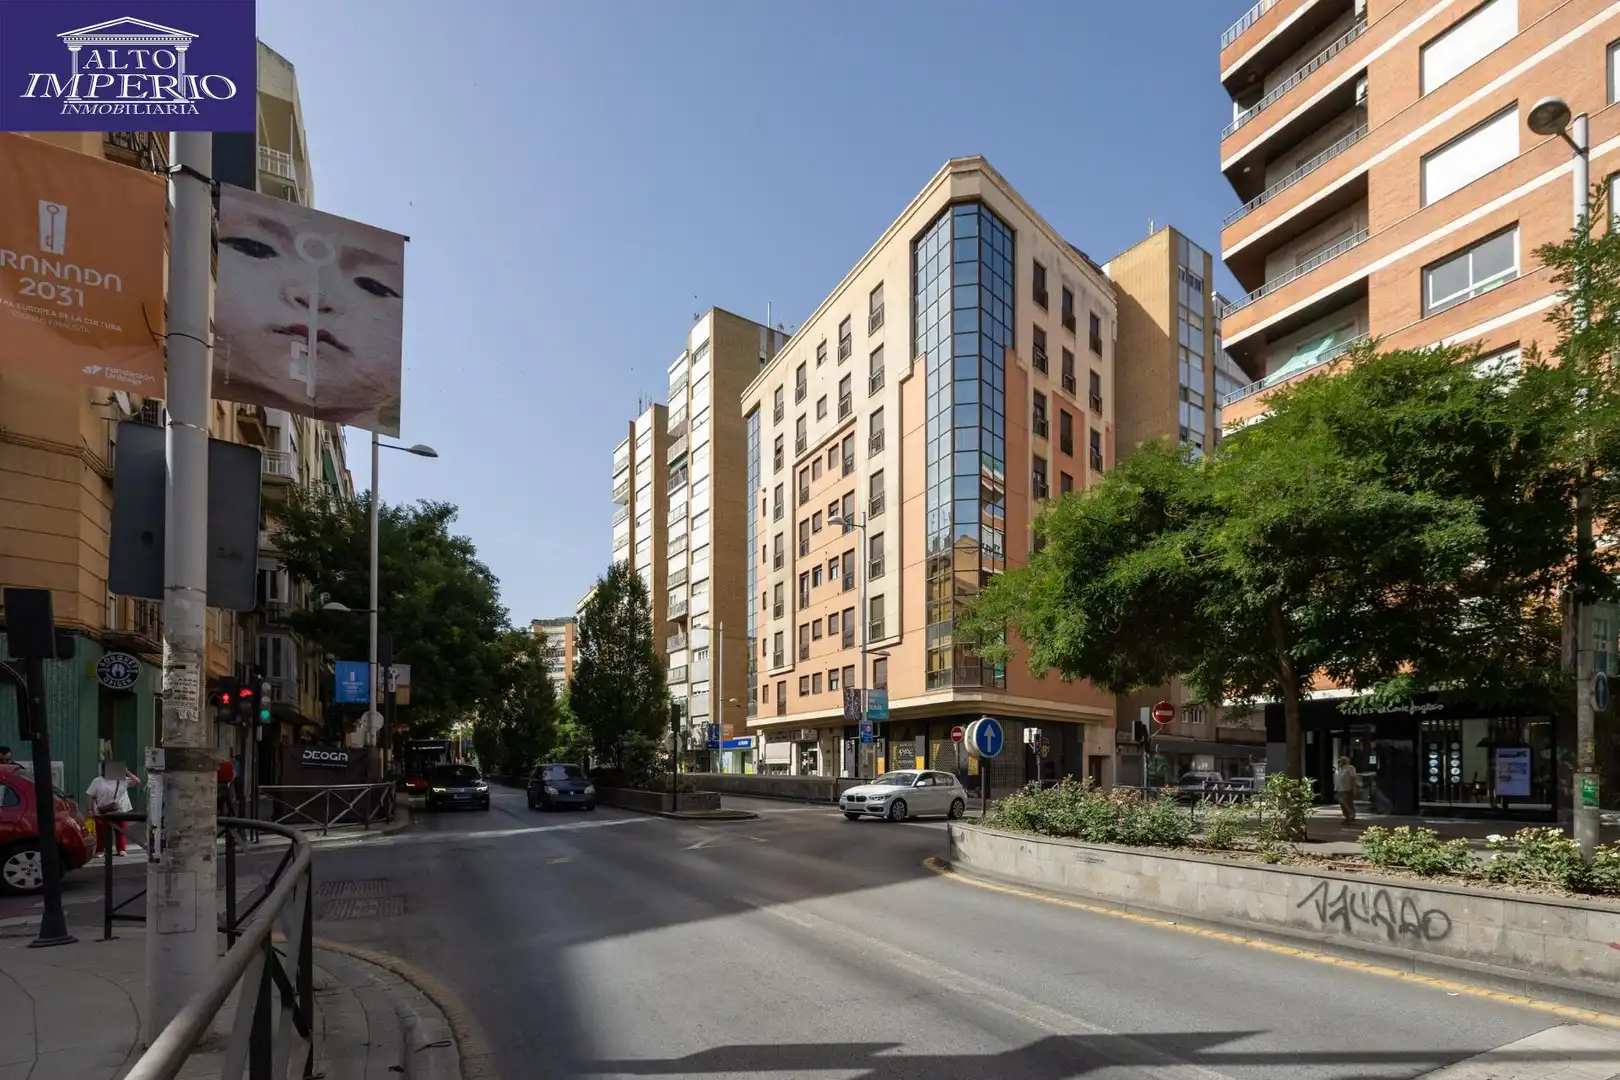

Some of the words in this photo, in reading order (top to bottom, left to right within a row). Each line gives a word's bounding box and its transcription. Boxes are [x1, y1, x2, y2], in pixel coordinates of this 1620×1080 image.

[19, 276, 85, 308] 2031
[71, 313, 83, 323] LA
[84, 316, 123, 333] CULTURA
